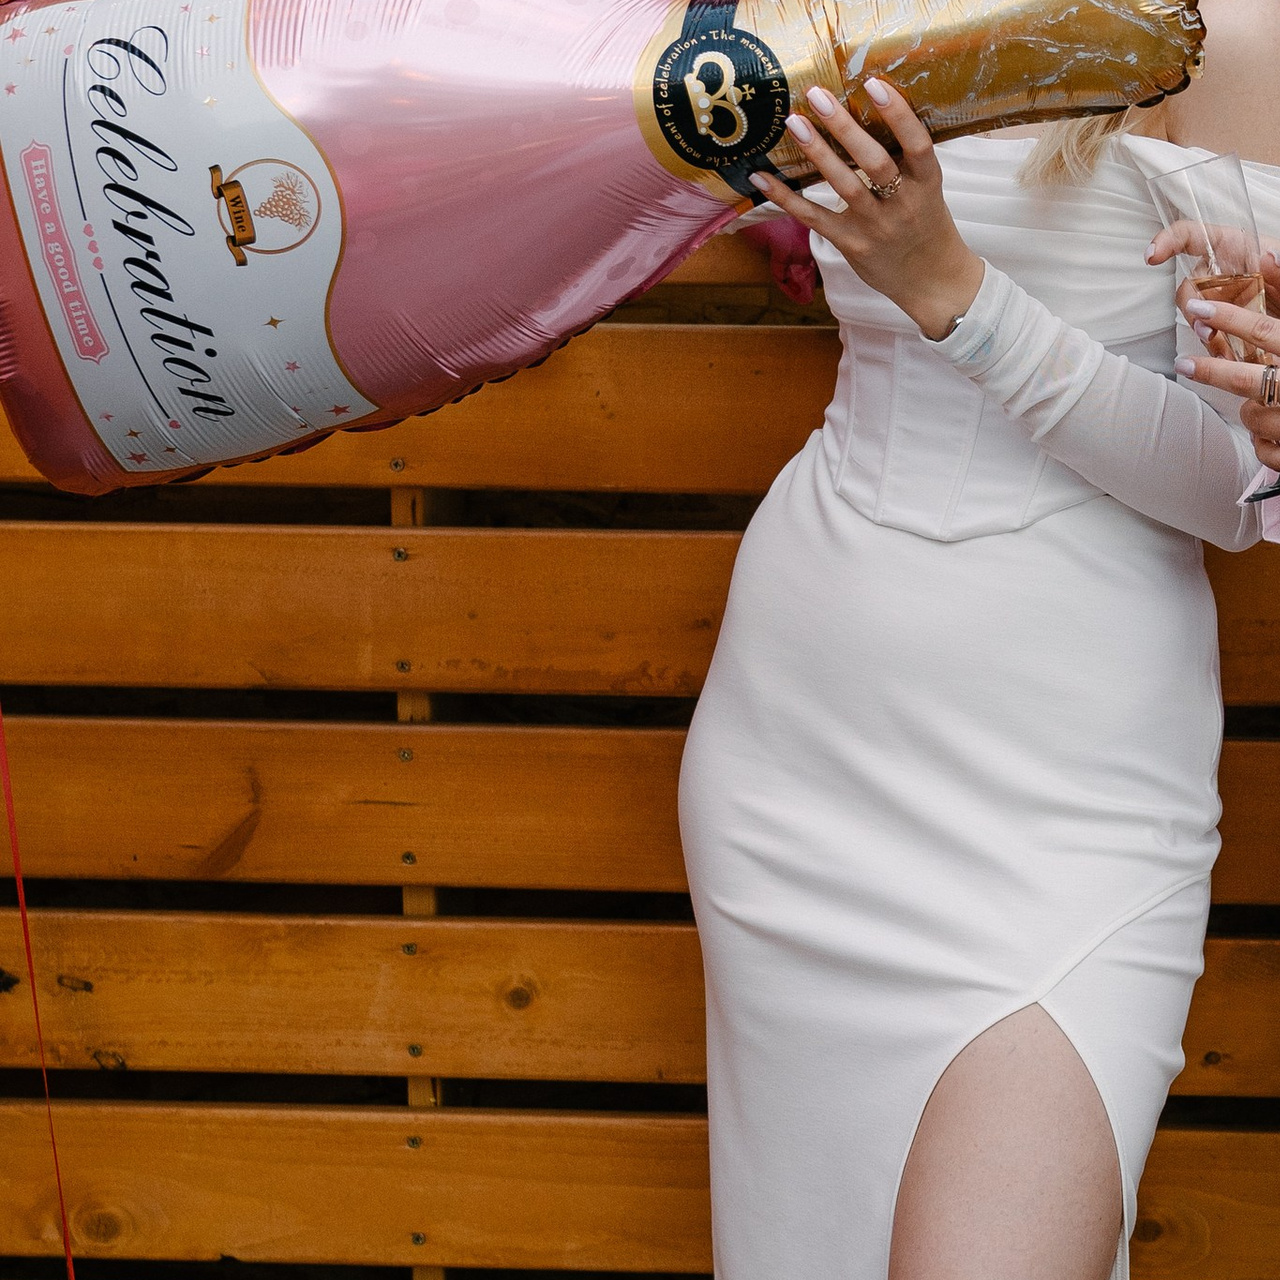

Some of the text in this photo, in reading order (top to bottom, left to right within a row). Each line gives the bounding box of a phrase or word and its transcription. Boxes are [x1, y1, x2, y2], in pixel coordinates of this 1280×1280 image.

[654, 37, 732, 169] The moment of celebration
[709, 30, 787, 157] The moment of celebration
[30, 157, 95, 348] Have a good time
[87, 25, 236, 423] Celebration
[228, 194, 248, 235] Wine
